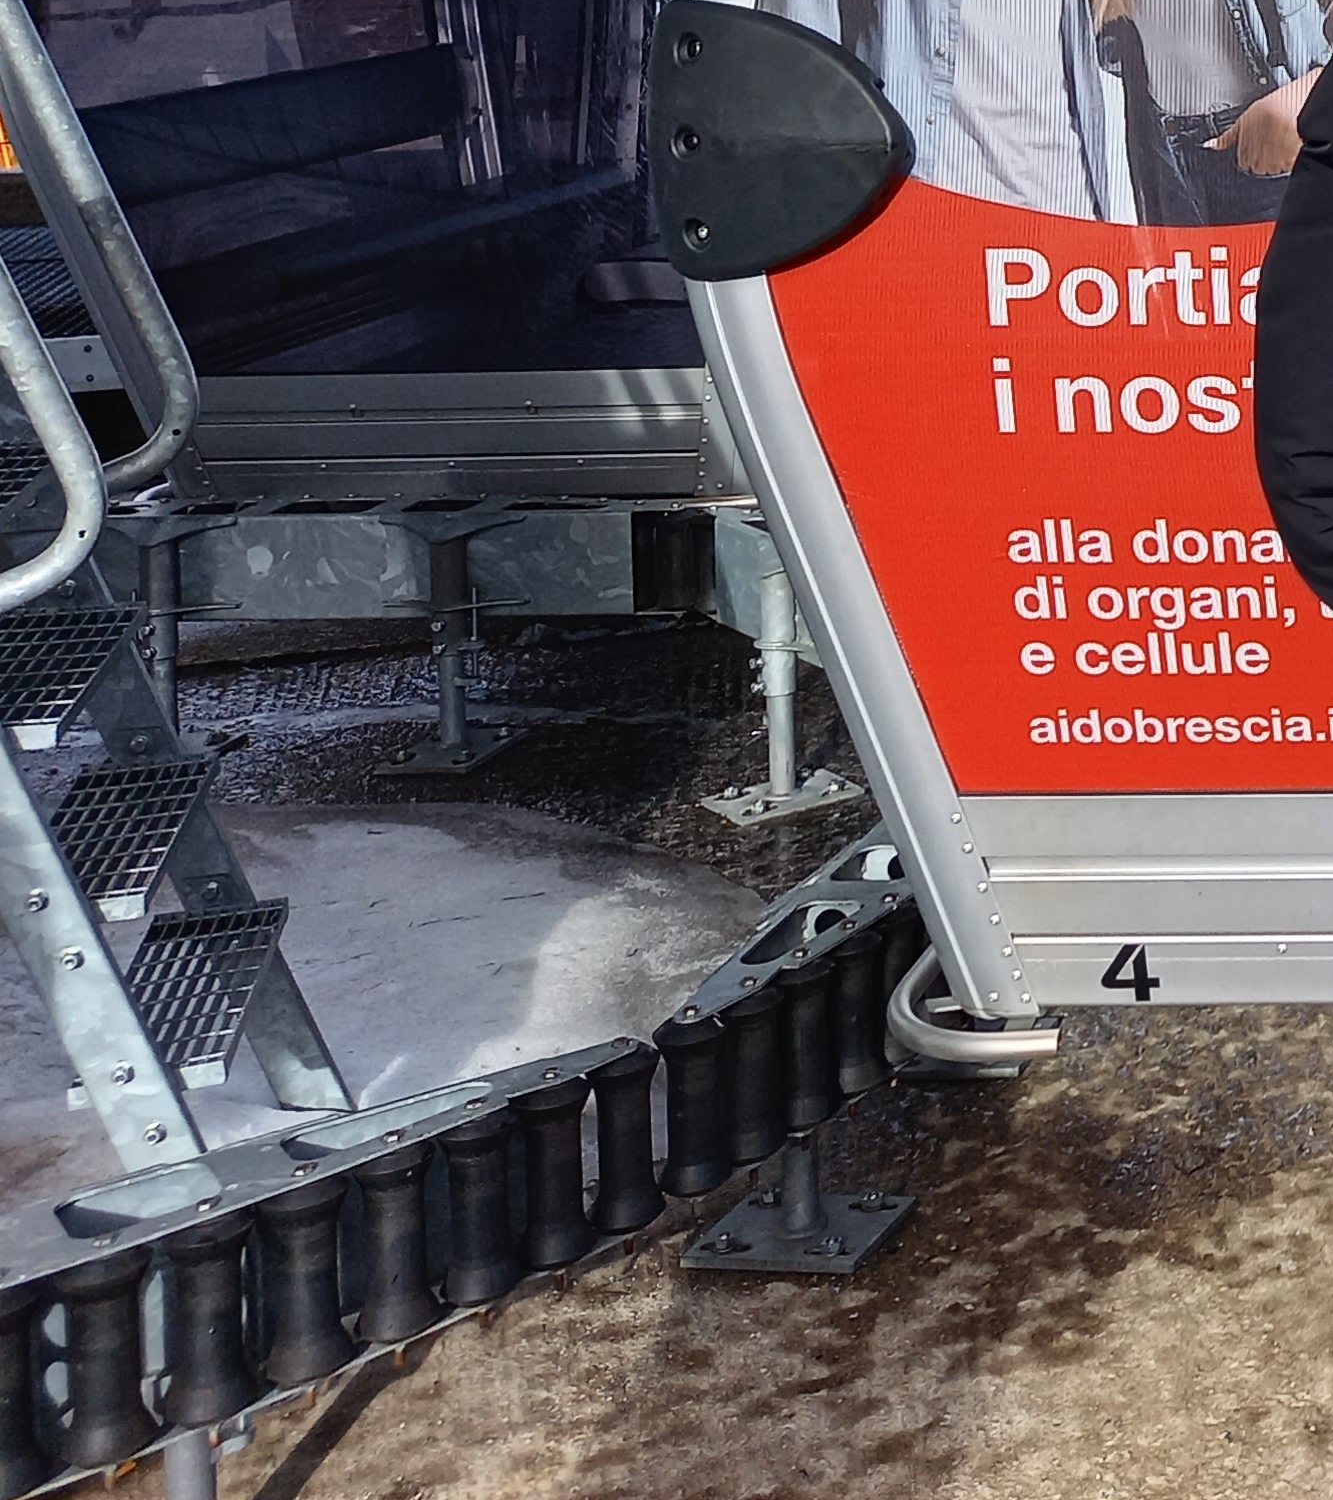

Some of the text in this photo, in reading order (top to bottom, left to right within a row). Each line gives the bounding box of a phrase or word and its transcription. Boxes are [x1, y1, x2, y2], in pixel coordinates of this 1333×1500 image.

[992, 357, 1016, 433] i
[1007, 519, 1291, 563] alla dona
[1014, 576, 1066, 620] di
[1087, 576, 1297, 630] organi,
[1020, 631, 1270, 674] e cellule
[1101, 944, 1160, 1001] 4
